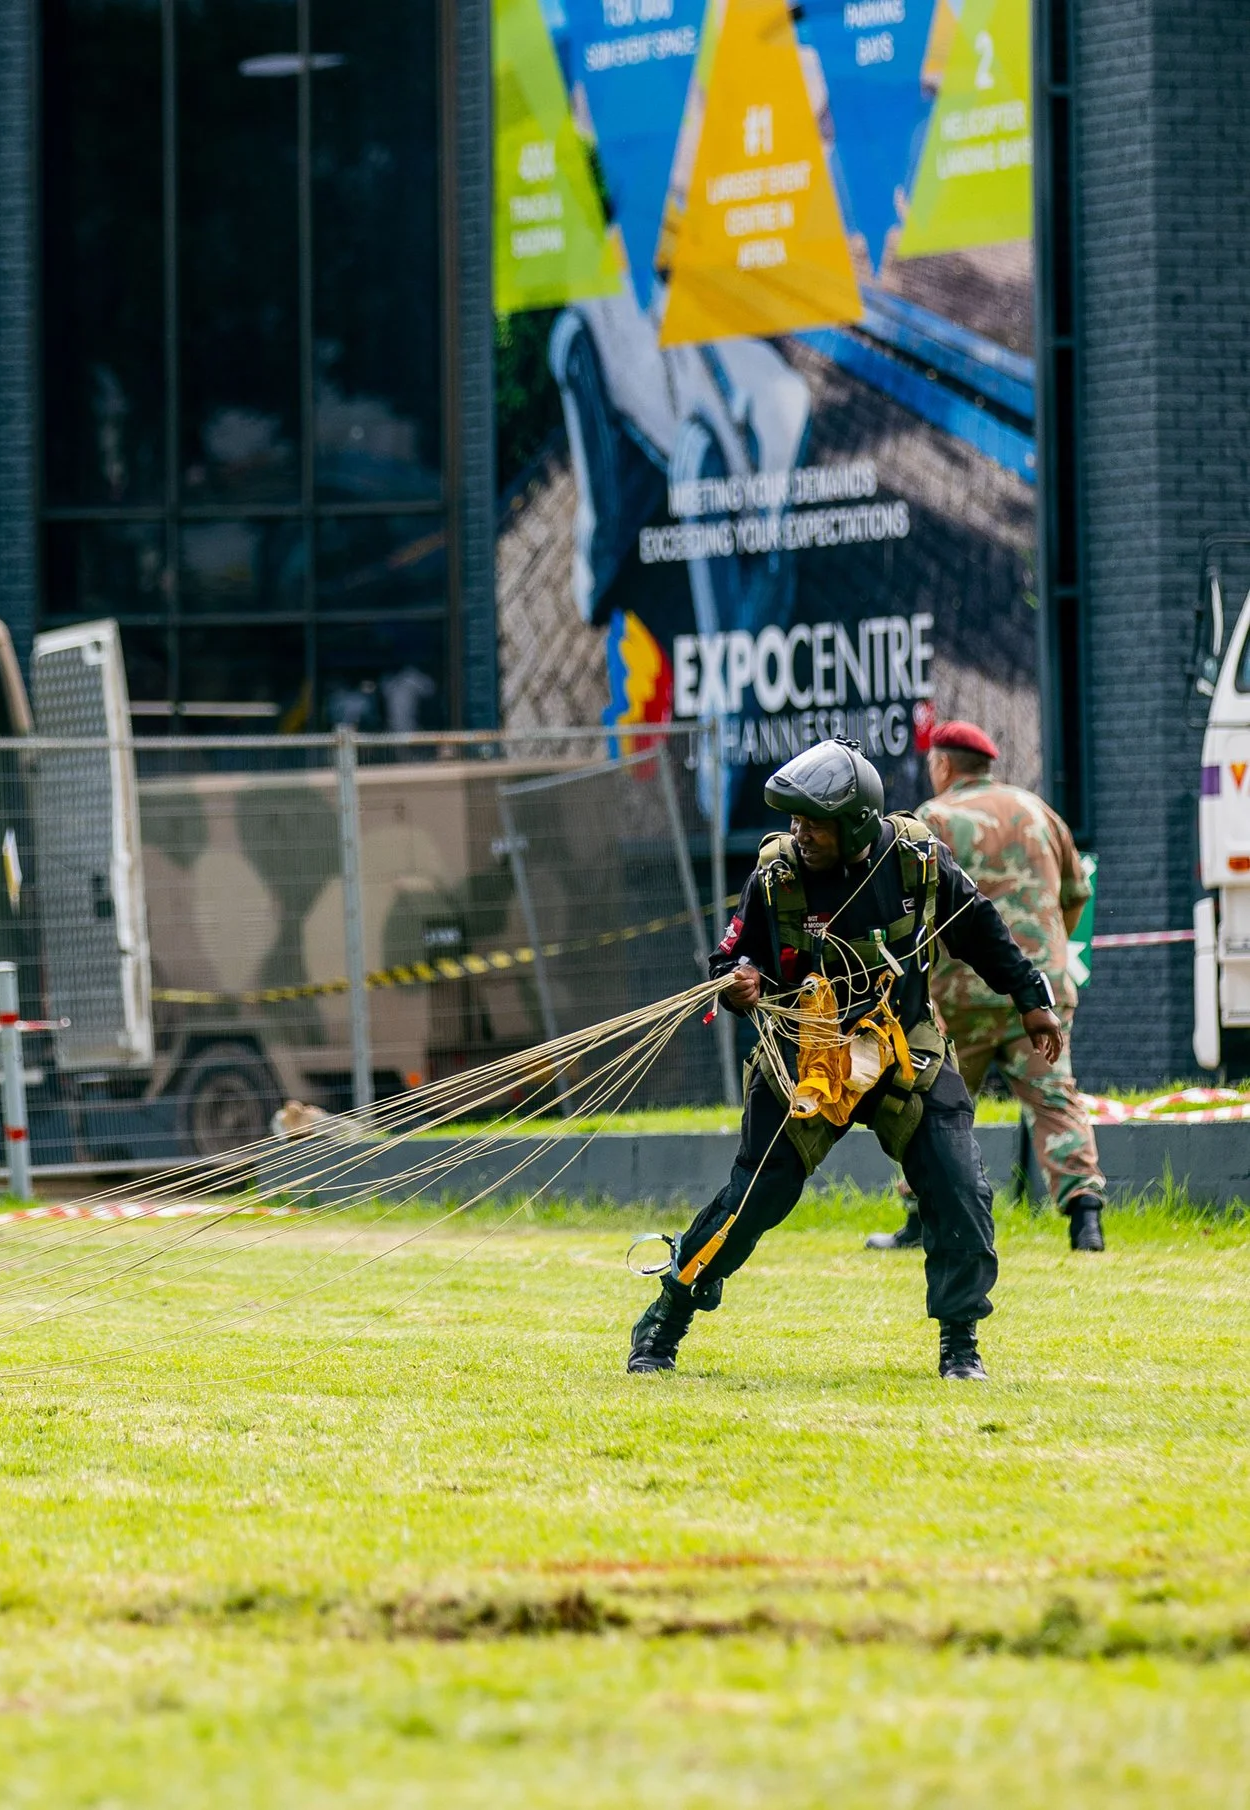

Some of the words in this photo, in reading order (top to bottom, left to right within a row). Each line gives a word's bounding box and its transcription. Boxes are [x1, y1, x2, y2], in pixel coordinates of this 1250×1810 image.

[975, 31, 994, 90] 2
[743, 104, 773, 157] #1
[669, 475, 743, 518] MEETING
[745, 470, 789, 511] YOUR
[791, 459, 878, 504] DEMANDS
[639, 520, 734, 564] EXCEEDING
[733, 512, 781, 554] YOUR
[782, 500, 910, 550] EXPECTATIONS
[674, 612, 936, 718] EXPOCENTRE
